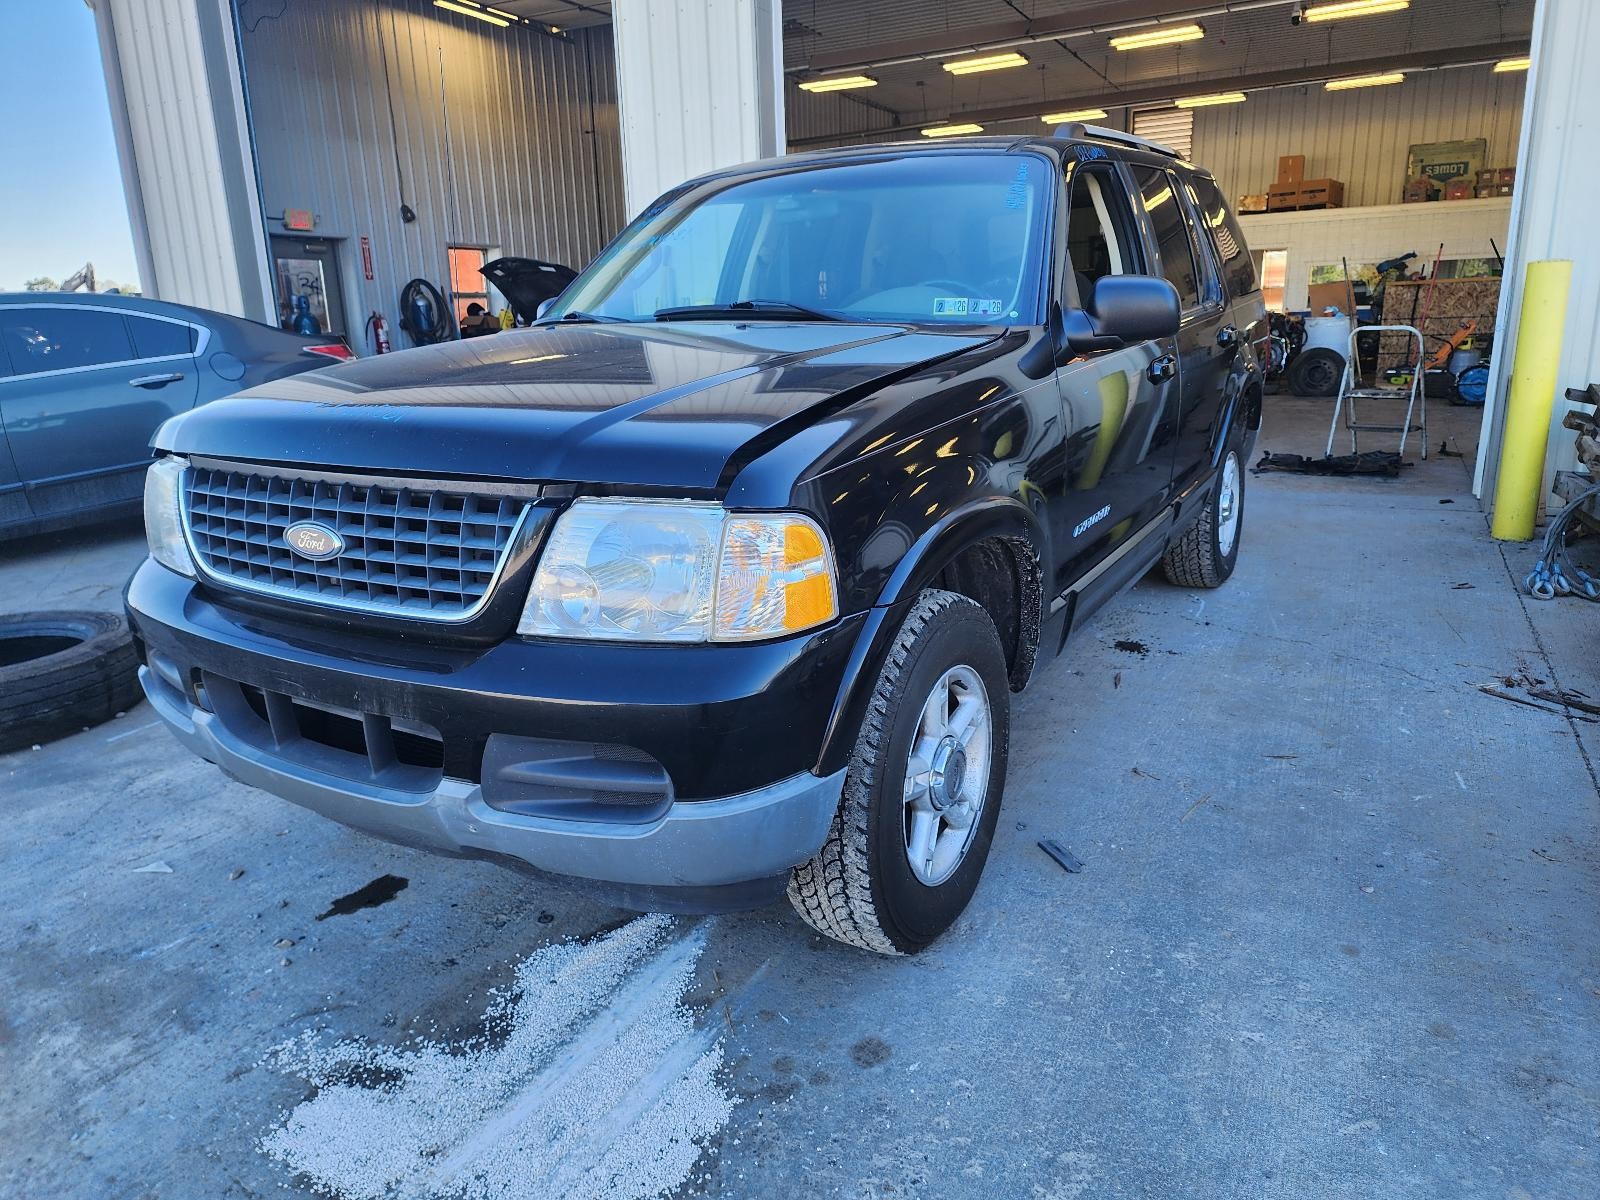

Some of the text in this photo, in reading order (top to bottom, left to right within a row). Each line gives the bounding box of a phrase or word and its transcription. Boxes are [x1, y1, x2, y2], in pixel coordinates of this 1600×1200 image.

[937, 301, 966, 313] 2 26
[992, 302, 1001, 313] 26
[298, 530, 325, 551] Ford
